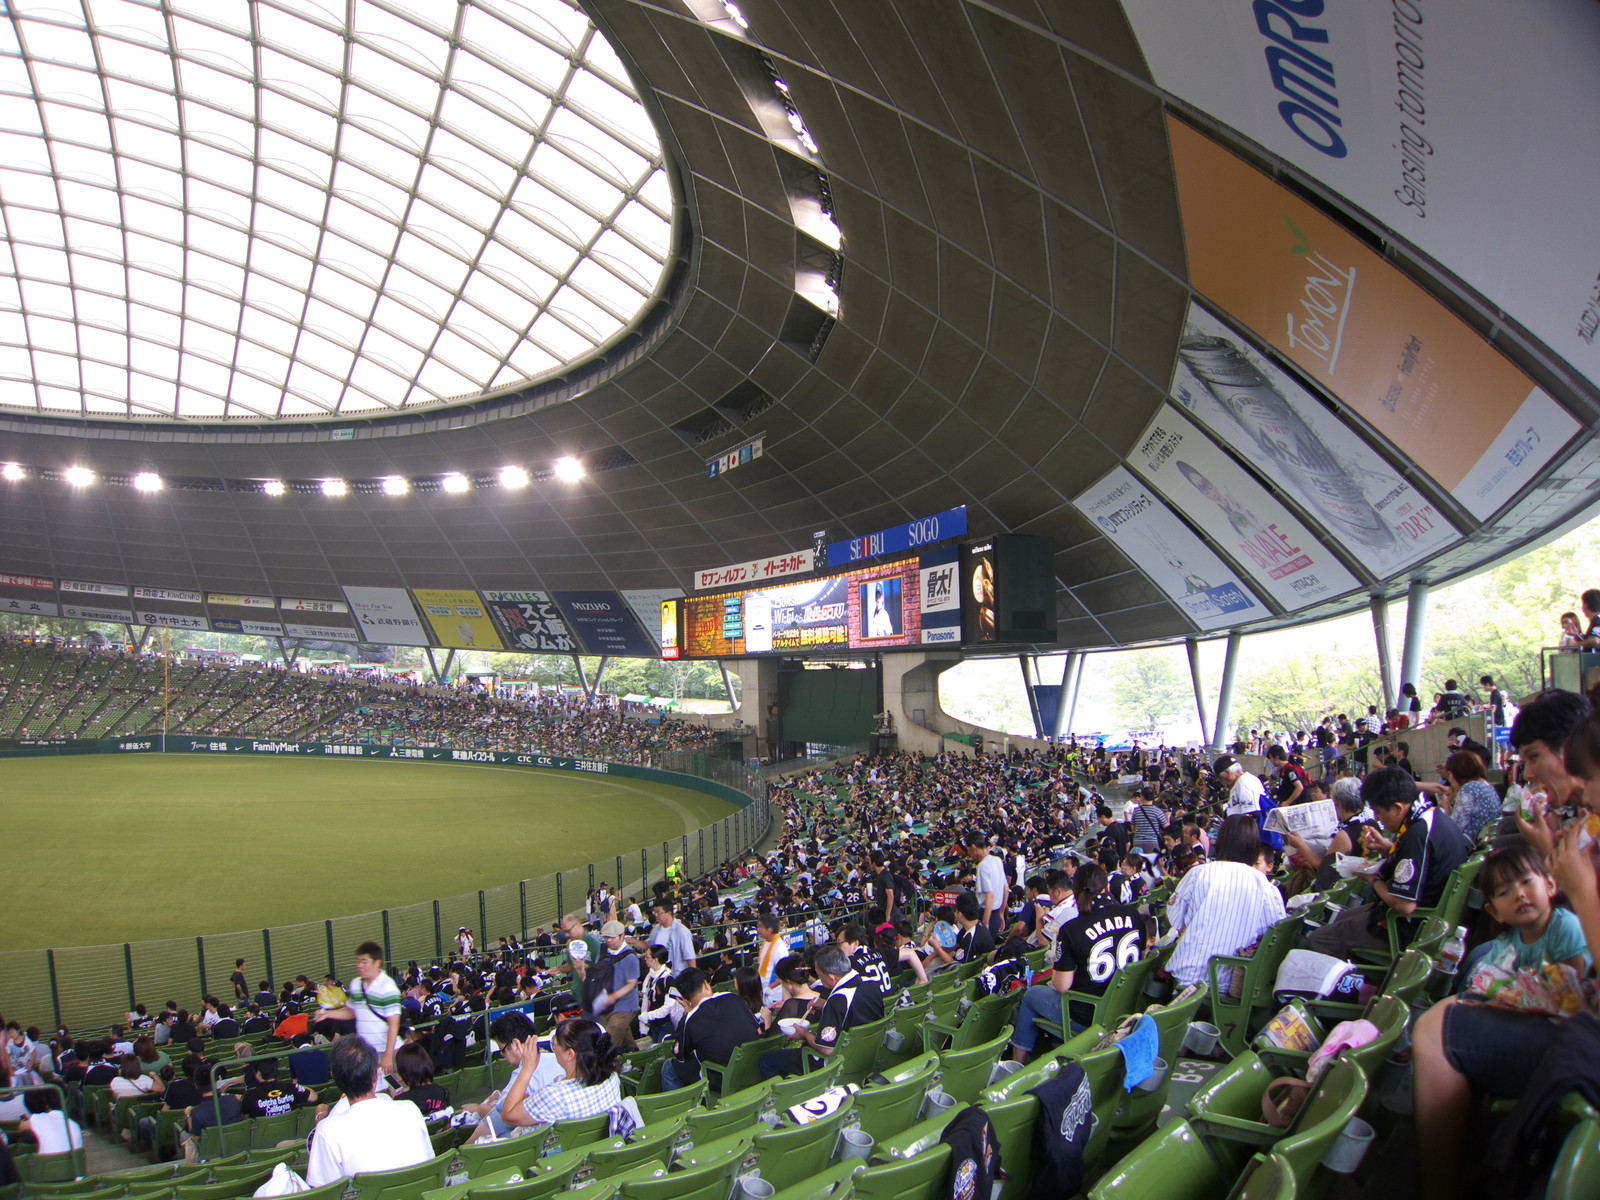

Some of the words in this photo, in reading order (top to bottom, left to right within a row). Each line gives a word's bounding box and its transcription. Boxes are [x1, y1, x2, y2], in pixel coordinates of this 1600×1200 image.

[1391, 0, 1424, 126] tomorro
[1392, 122, 1434, 219] Sensing
[850, 532, 885, 560] SEIBU
[908, 516, 939, 547] SOGO
[1239, 523, 1302, 570] BIVALE
[927, 567, 954, 599] 骨太!
[1292, 575, 1320, 592] HITACHI
[167, 591, 200, 601] KANDENKO
[490, 592, 541, 602] PICKLES
[306, 602, 334, 612] 三菱電機
[571, 602, 611, 612] MIZUHO
[159, 616, 201, 627] 竹中土木
[927, 629, 955, 642] Panasonic
[252, 741, 299, 753] FamilyMart
[517, 755, 532, 763] CTC
[537, 757, 552, 765] CTC
[846, 891, 860, 903] 26
[1085, 915, 1133, 941] OKADA
[1087, 929, 1141, 984] 66
[433, 1004, 442, 1016] 3
[1223, 1022, 1237, 1040] 7
[1170, 1060, 1217, 1084] B-3
